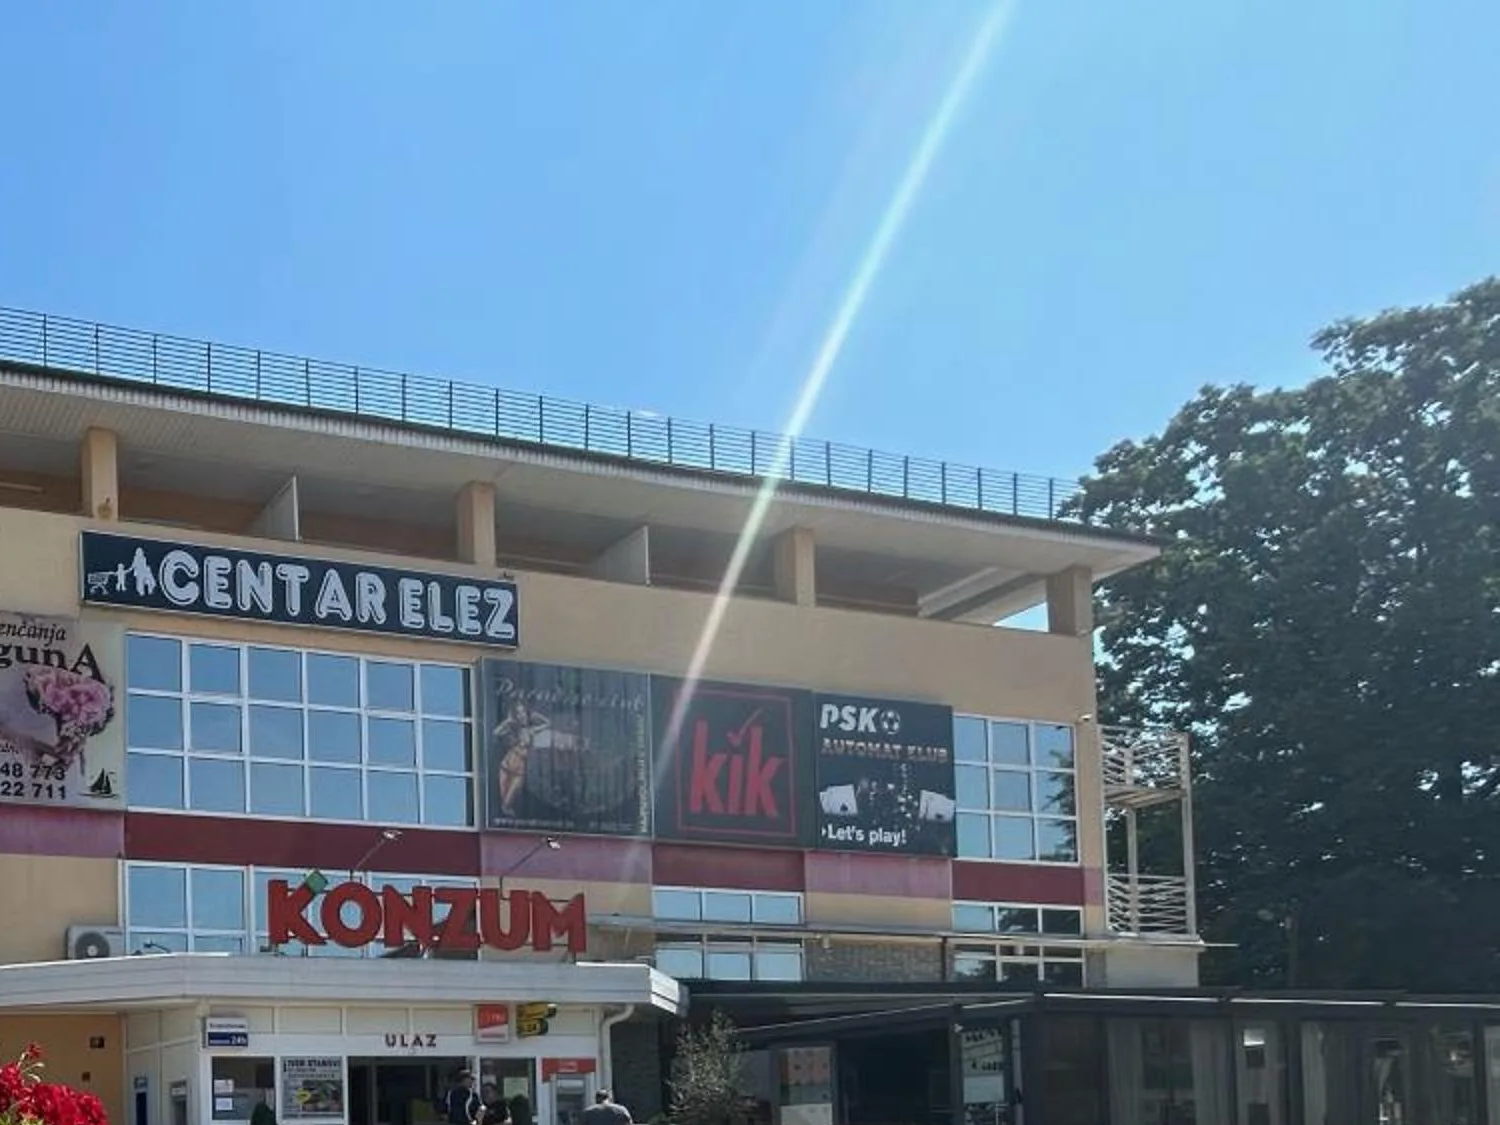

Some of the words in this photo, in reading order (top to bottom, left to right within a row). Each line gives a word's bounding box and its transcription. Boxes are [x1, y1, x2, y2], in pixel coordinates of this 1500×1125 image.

[158, 549, 387, 625] CENTAR
[398, 578, 516, 639] ELEZ
[820, 703, 879, 733] PSK
[820, 737, 903, 760] AUTOMAT
[907, 745, 949, 764] KLUB
[0, 762, 24, 778] 48
[30, 765, 66, 781] 773
[0, 781, 25, 797] 22
[31, 783, 67, 800] 711
[827, 823, 865, 841] Let's
[869, 827, 908, 847] play!
[267, 878, 587, 953] KONZUM
[384, 1032, 437, 1048] ULAZ
